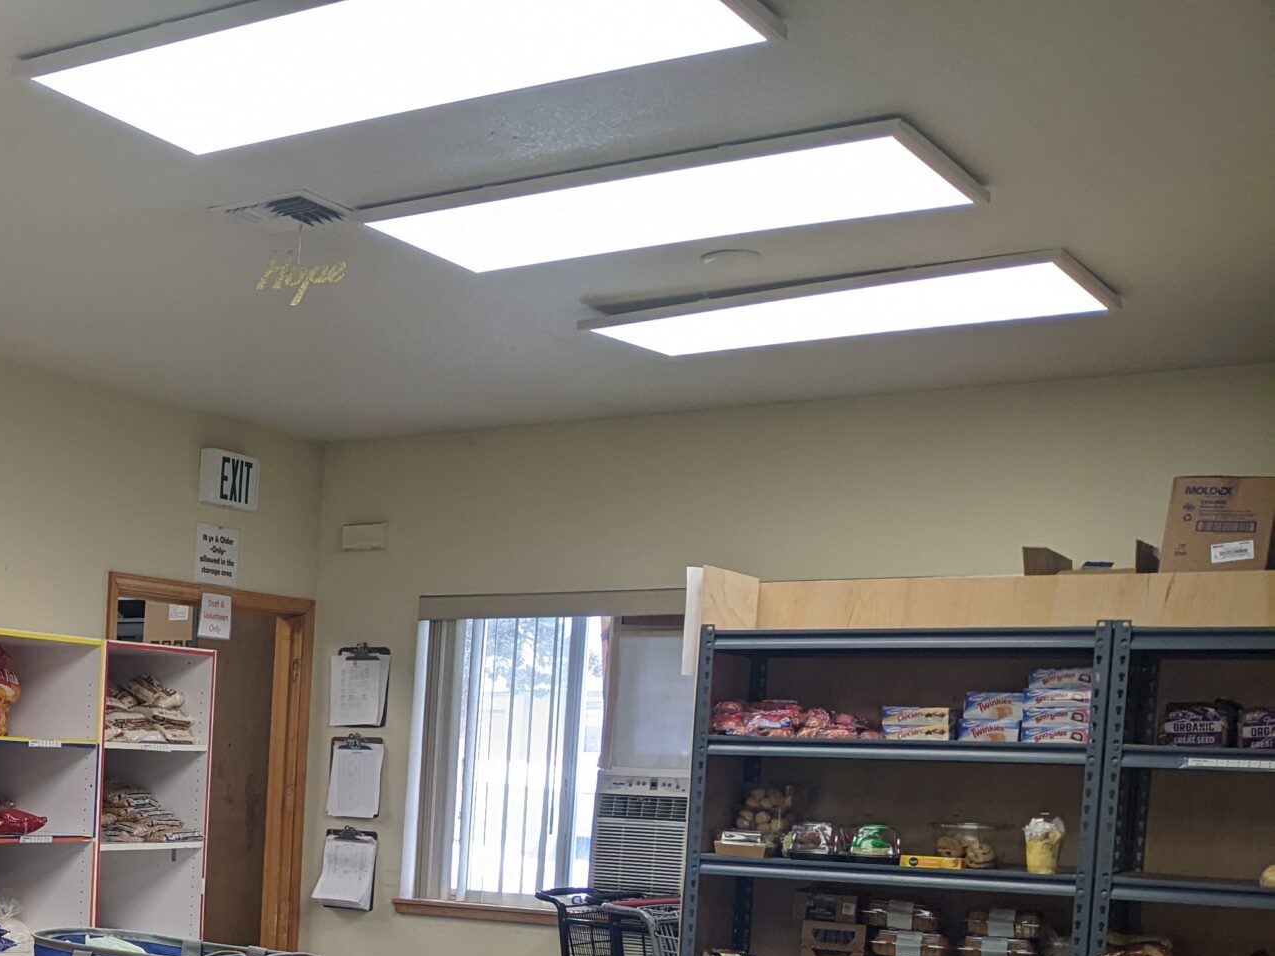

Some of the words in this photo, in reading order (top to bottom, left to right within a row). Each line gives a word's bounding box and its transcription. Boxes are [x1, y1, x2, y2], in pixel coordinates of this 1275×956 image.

[219, 456, 254, 505] EXIT
[1184, 486, 1235, 496] MOLDEX
[209, 624, 221, 634] Only
[977, 698, 1012, 712] Twinkies
[970, 724, 1005, 738] Twinkies
[1173, 722, 1215, 732] ORGANIC
[1196, 736, 1215, 744] SEED
